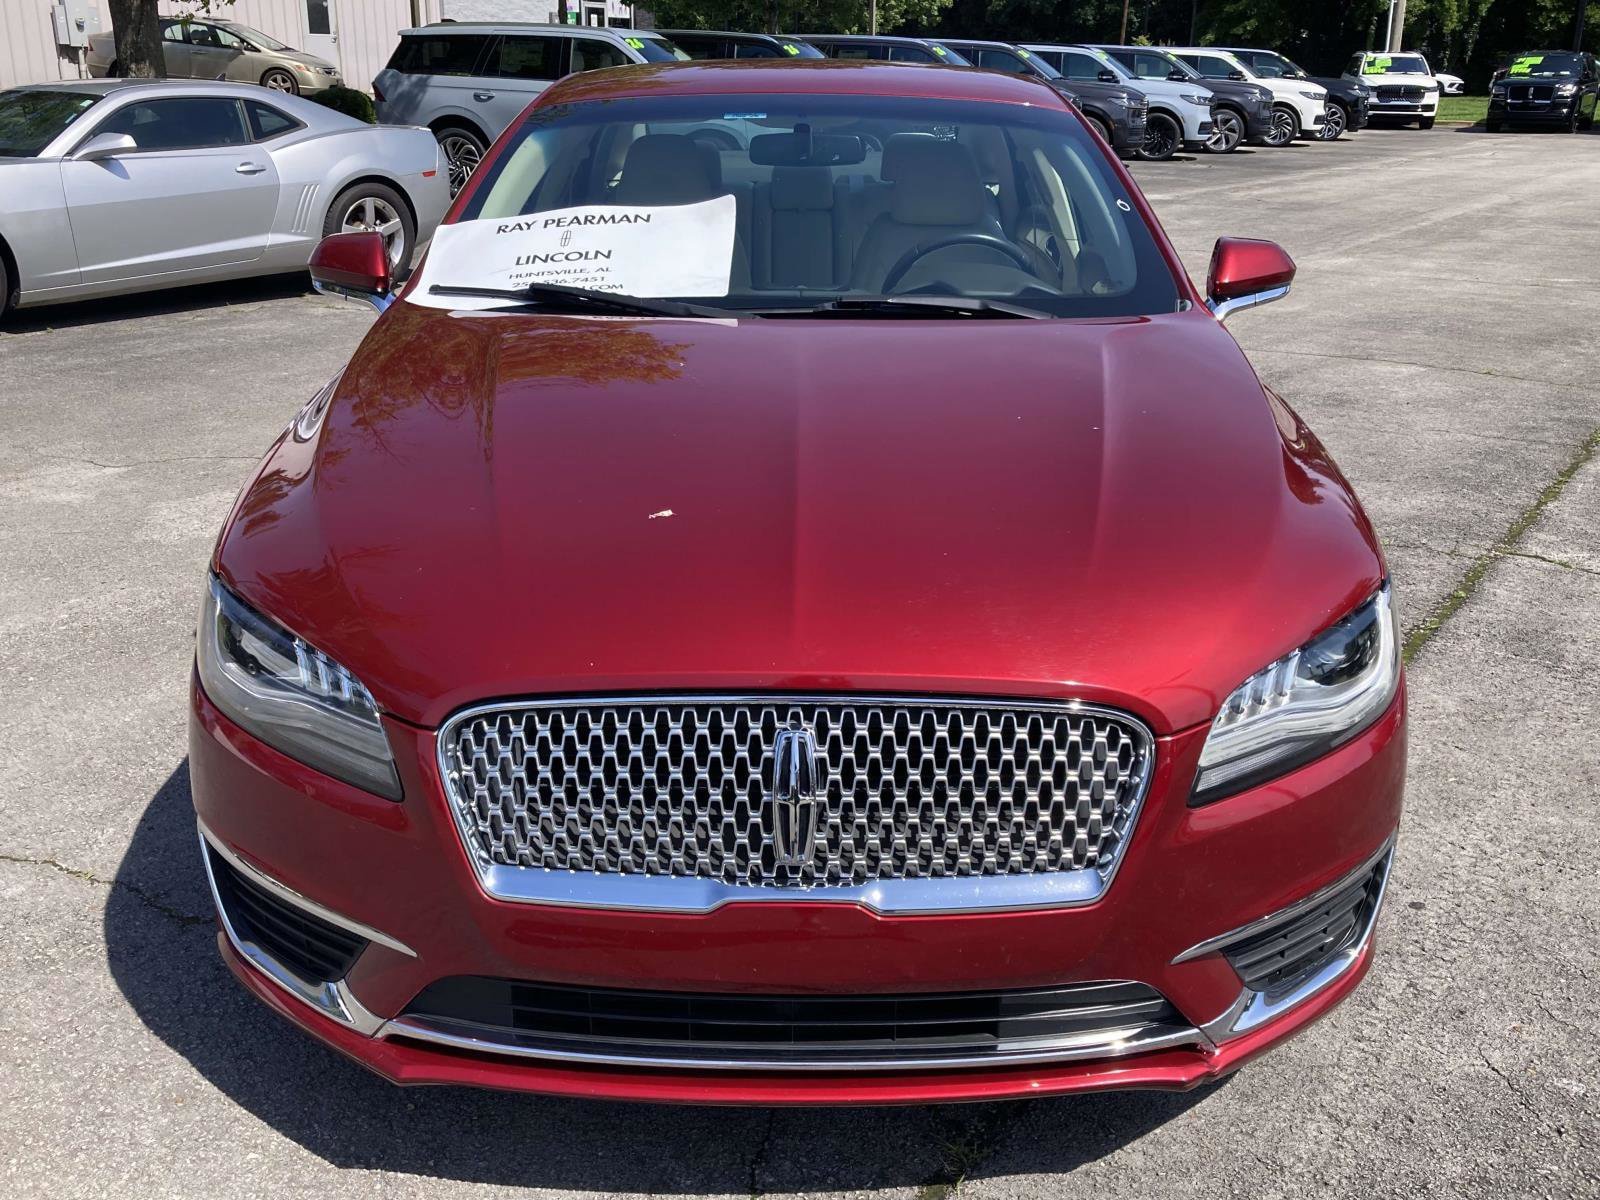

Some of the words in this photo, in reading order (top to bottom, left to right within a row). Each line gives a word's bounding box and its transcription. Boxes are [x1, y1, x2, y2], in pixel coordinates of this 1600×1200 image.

[496, 220, 538, 235] RAY
[543, 213, 652, 229] PEARMAN
[515, 250, 613, 266] LINCOLN
[508, 267, 590, 280] HUNTSVILLE,
